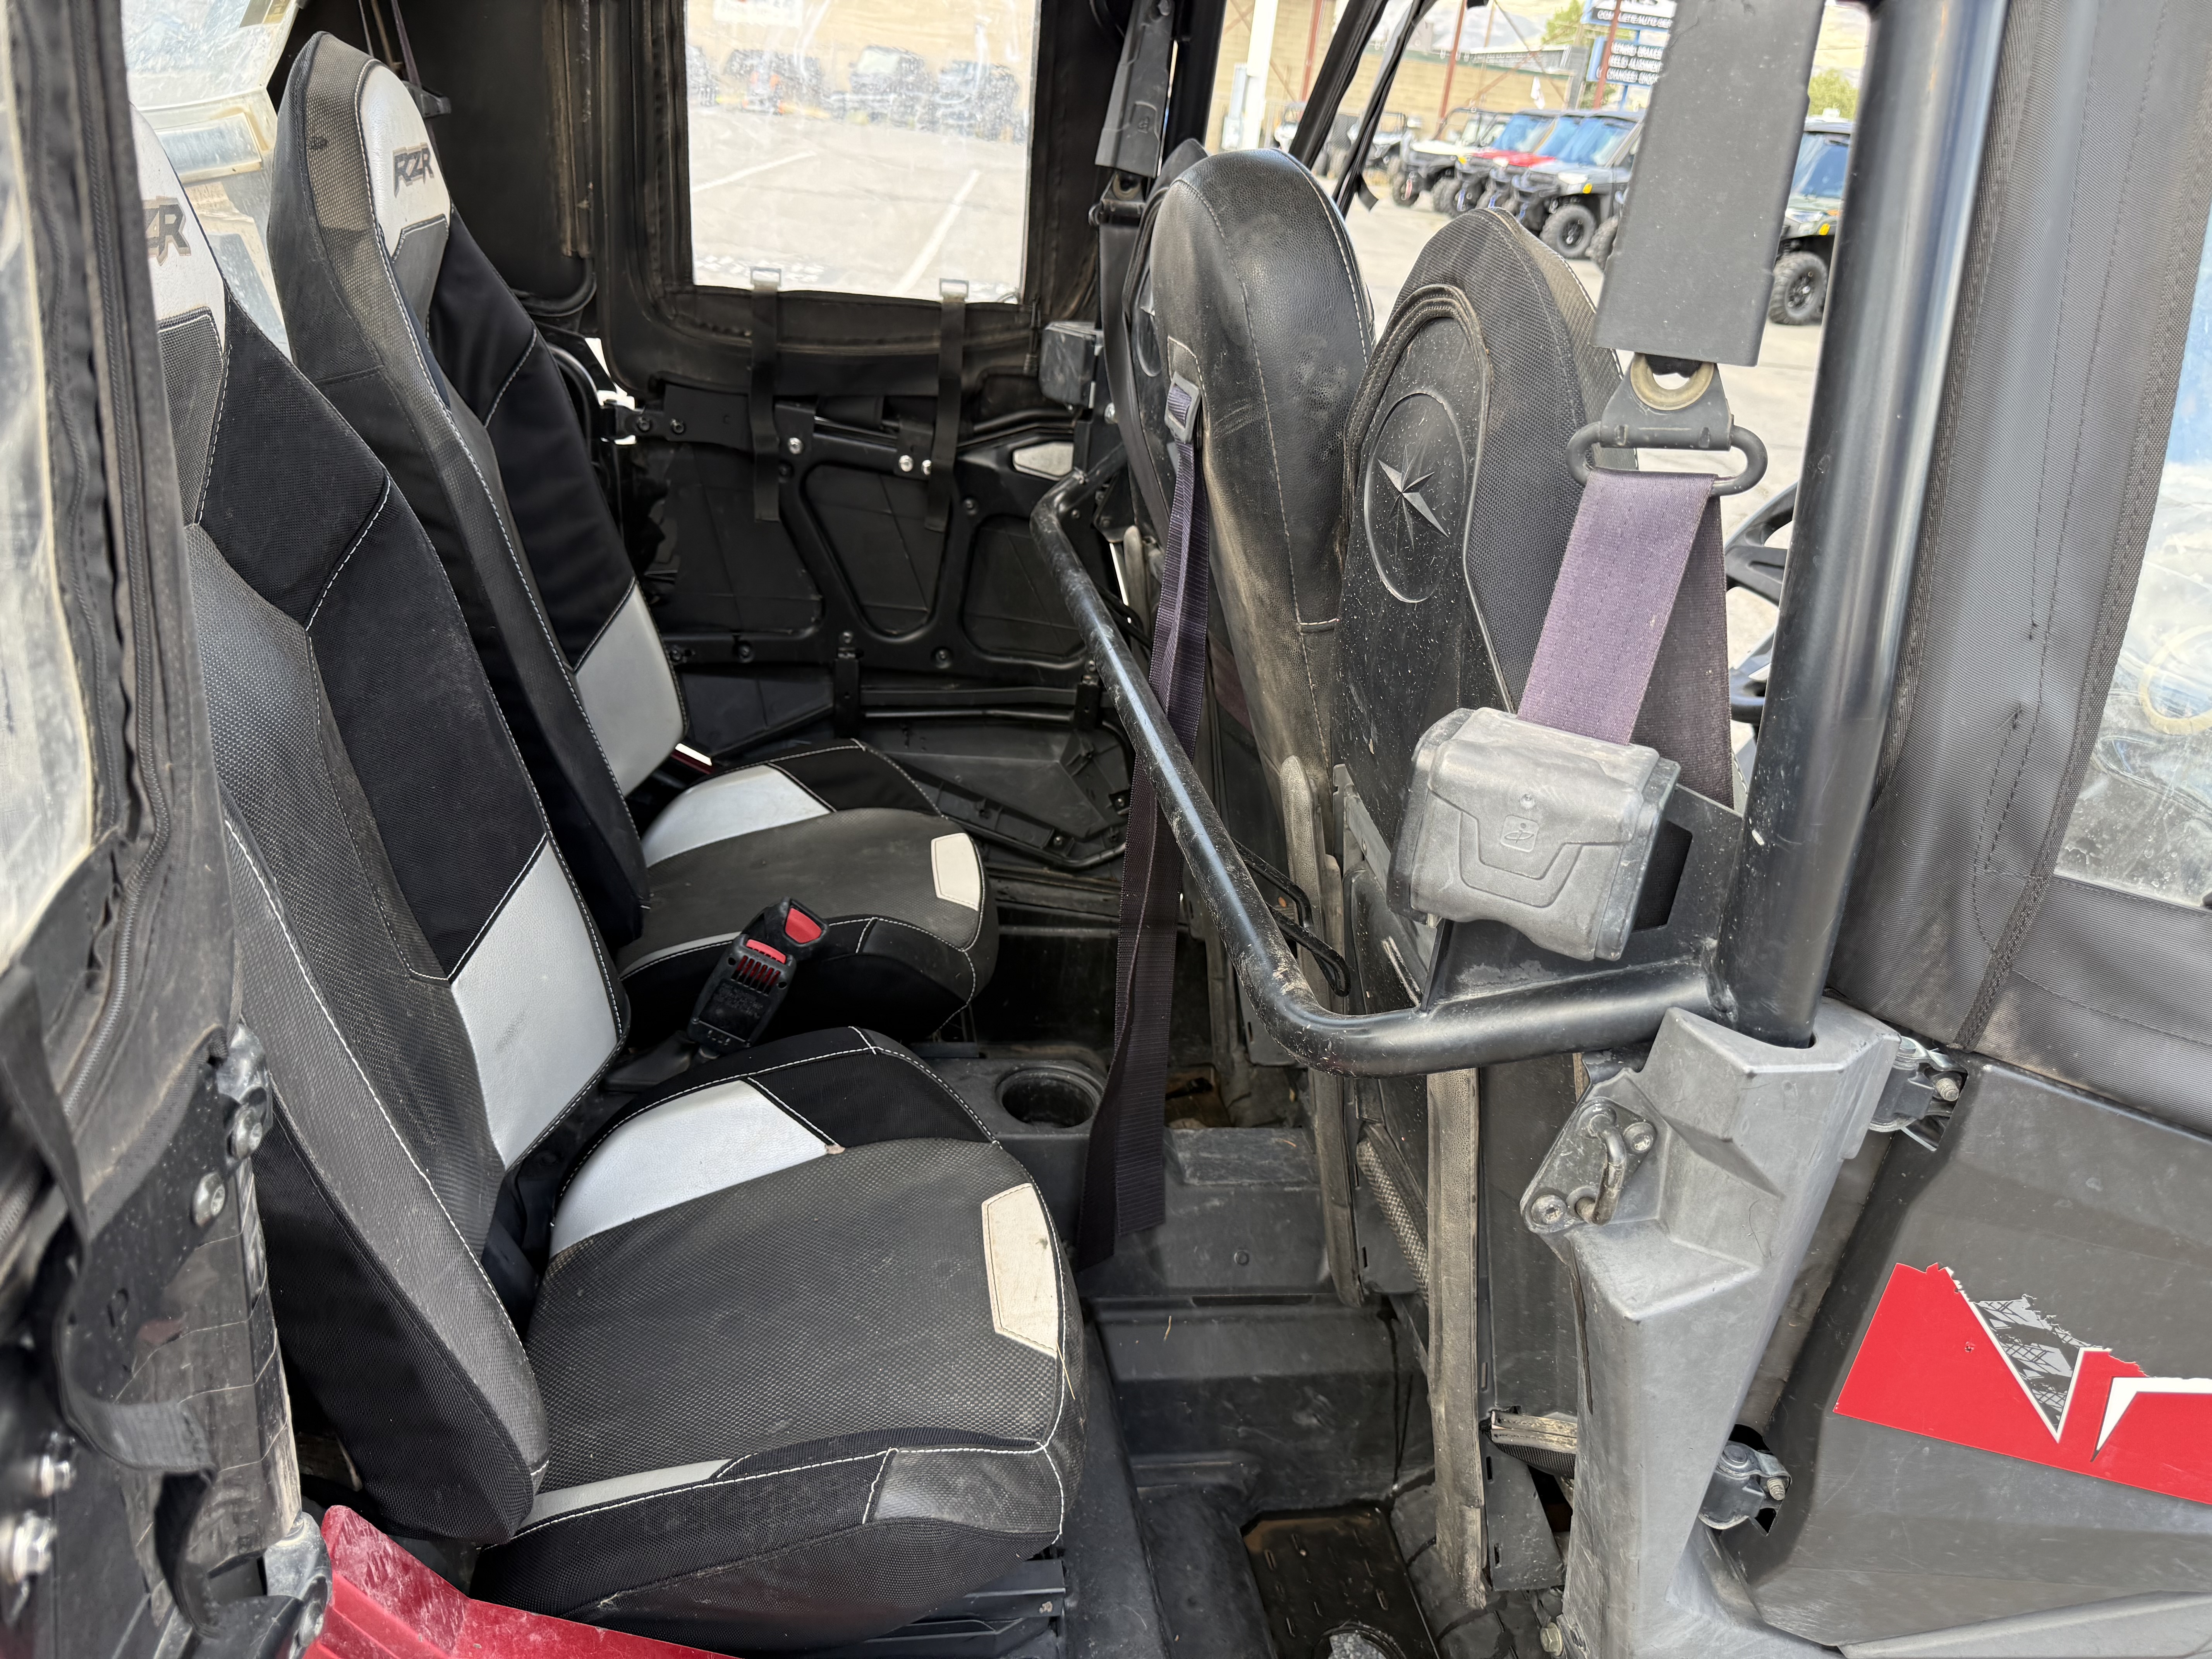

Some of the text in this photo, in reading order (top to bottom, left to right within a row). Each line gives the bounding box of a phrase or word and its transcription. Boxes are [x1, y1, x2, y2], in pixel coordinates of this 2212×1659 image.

[1597, 9, 1637, 24] COMLETE
[393, 143, 434, 198] RZR
[143, 196, 191, 266] ZR
